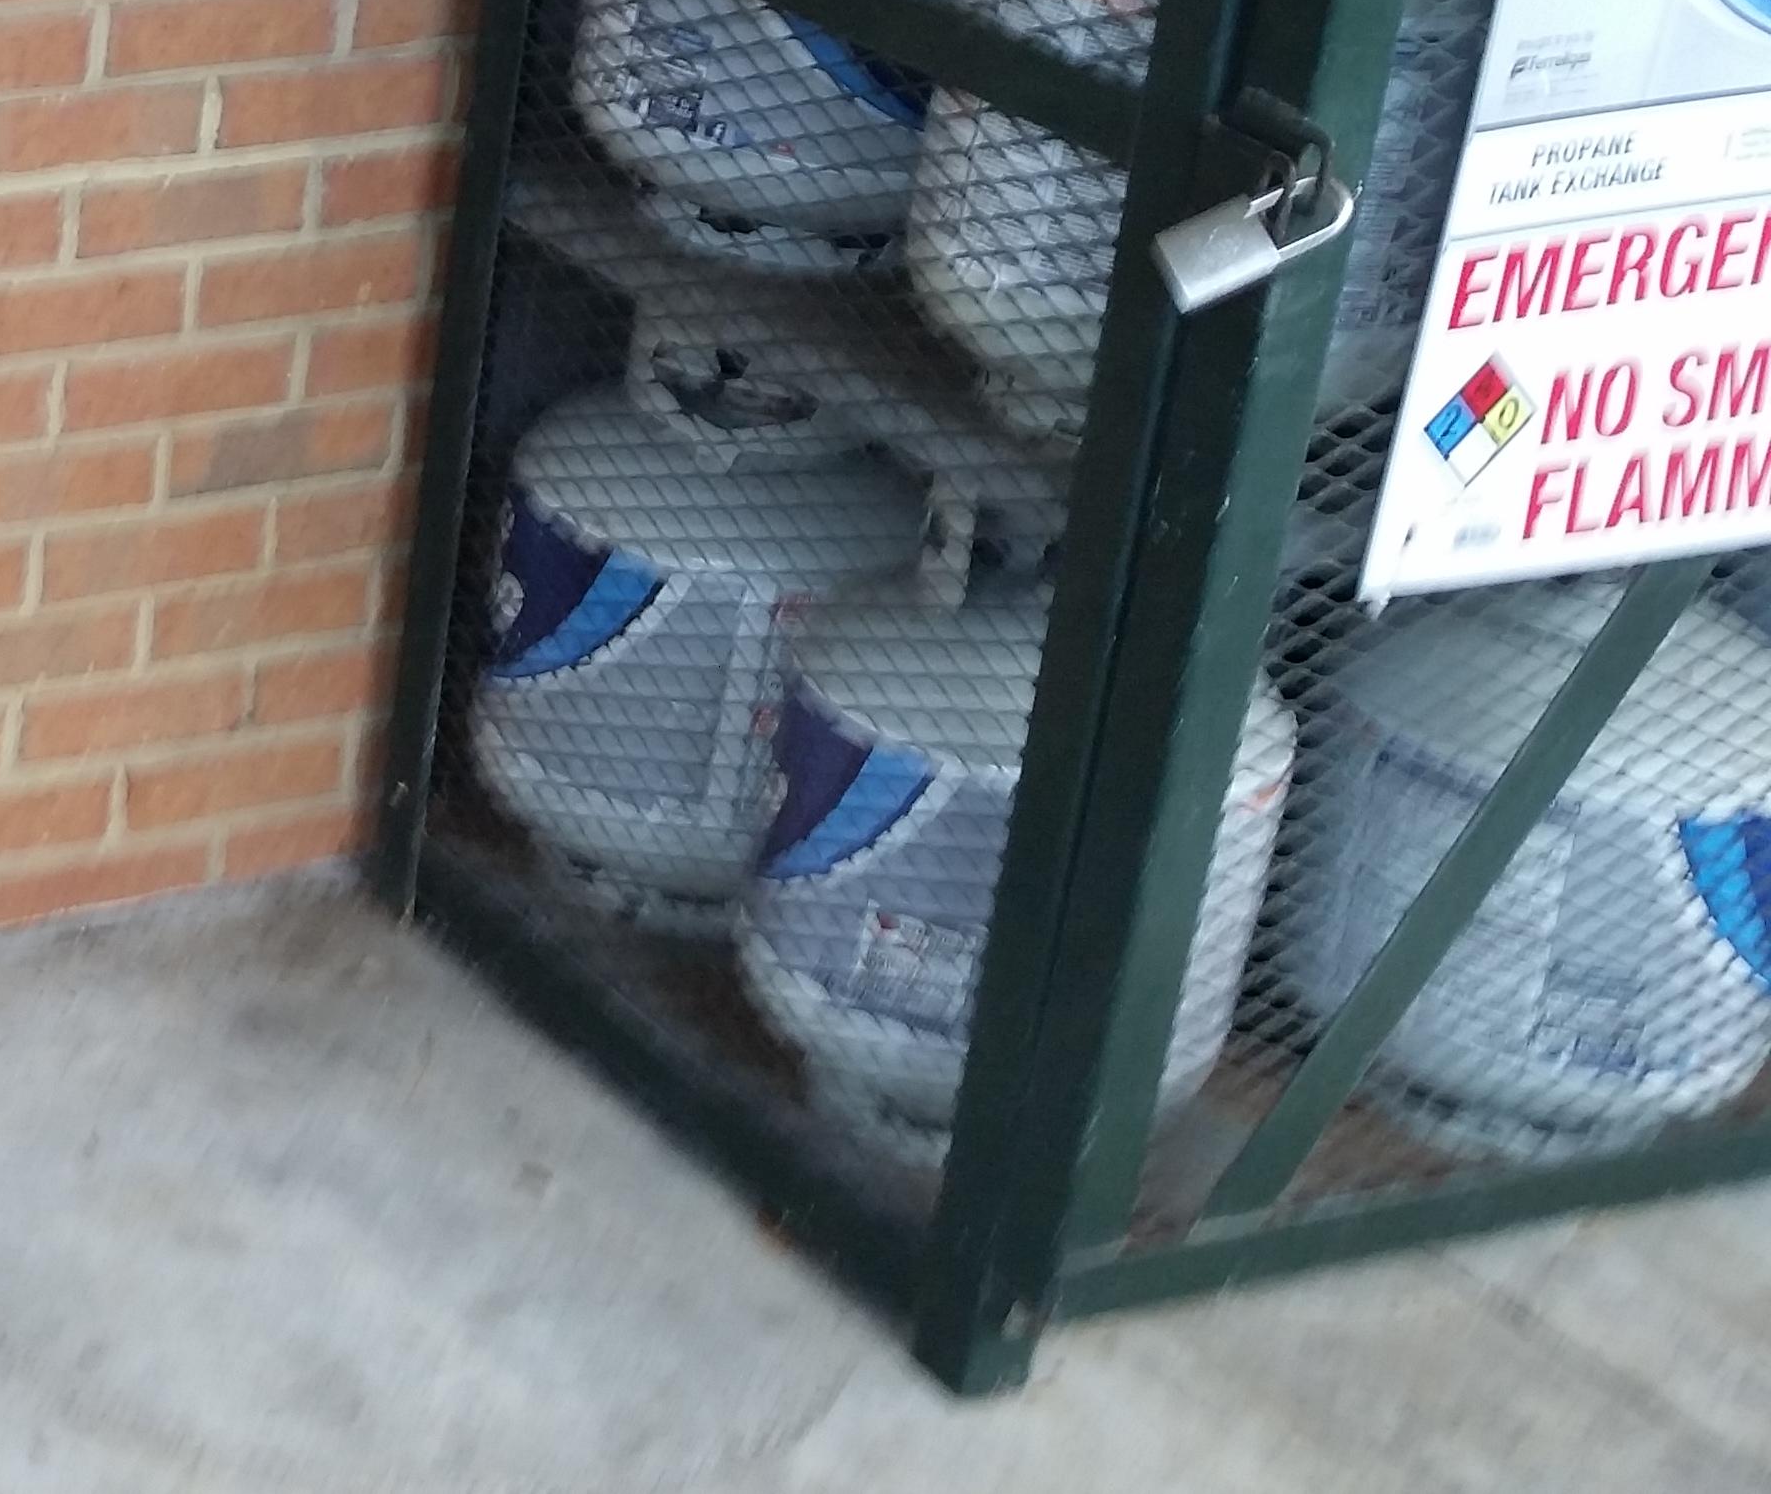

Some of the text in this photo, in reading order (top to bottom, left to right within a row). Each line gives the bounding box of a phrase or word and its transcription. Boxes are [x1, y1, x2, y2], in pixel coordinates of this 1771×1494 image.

[1531, 130, 1638, 167] PROPANE
[1490, 157, 1668, 205] TANK EXCHANGE
[1540, 358, 1643, 446] NO
